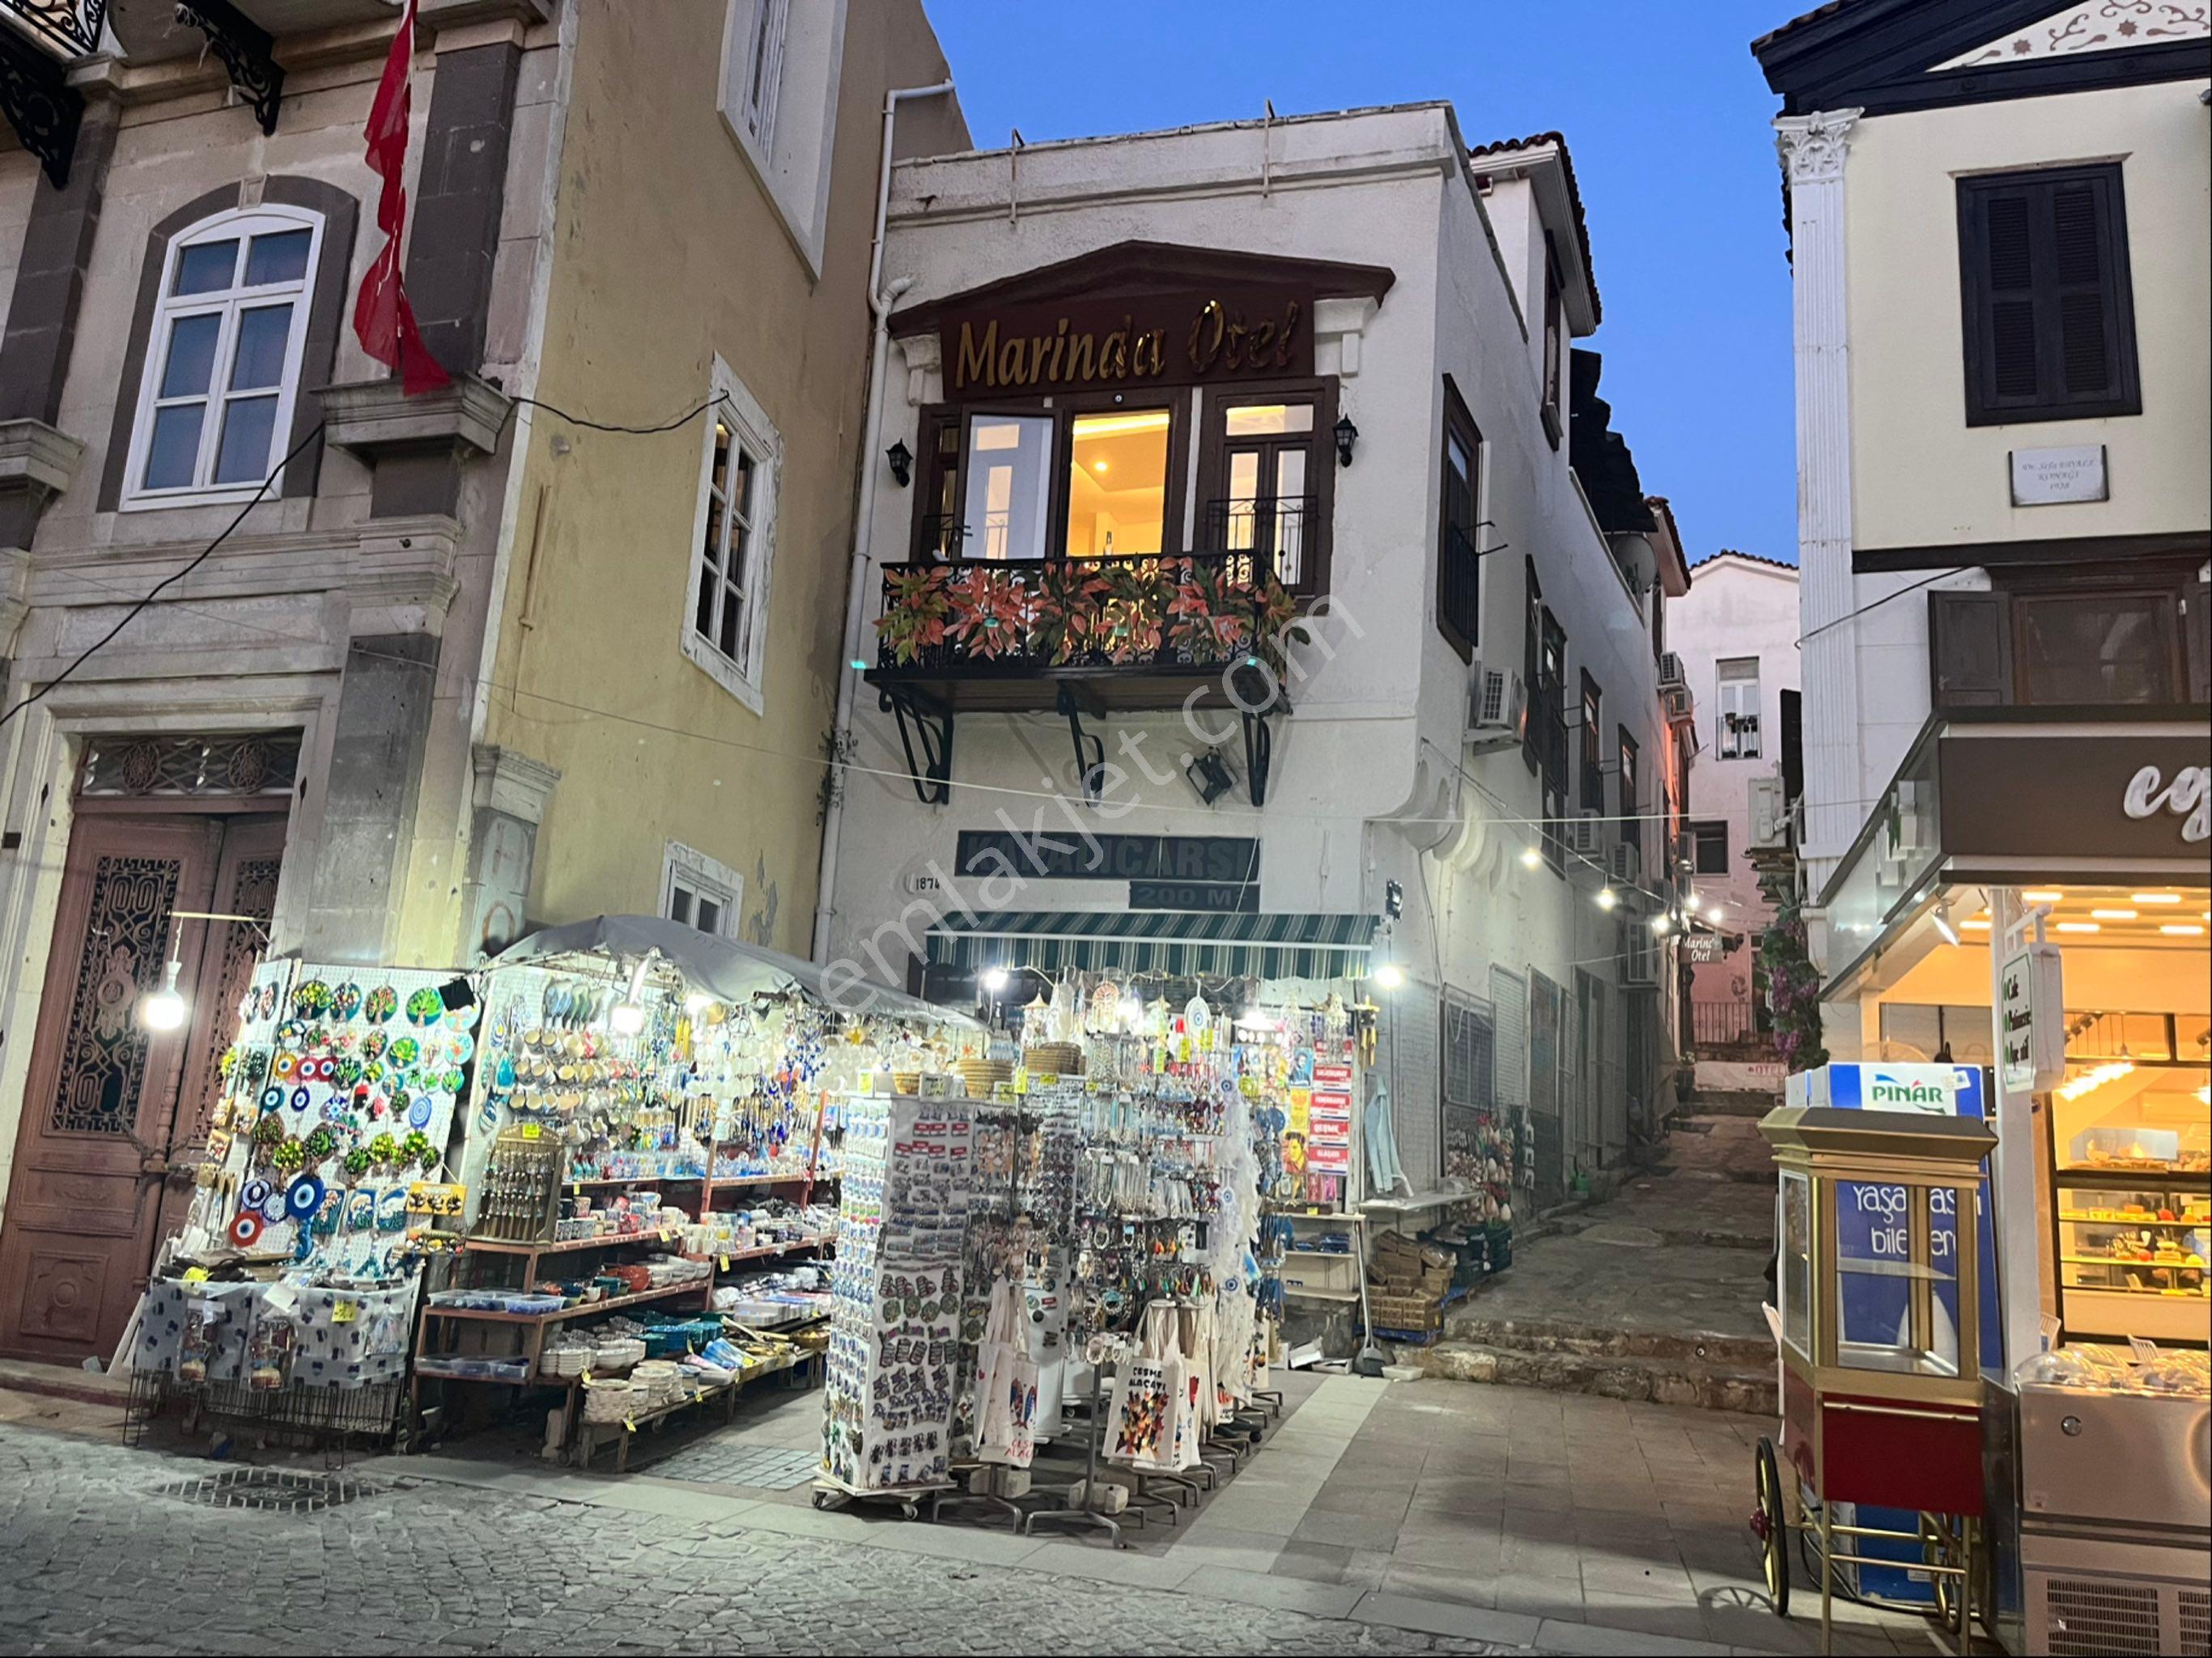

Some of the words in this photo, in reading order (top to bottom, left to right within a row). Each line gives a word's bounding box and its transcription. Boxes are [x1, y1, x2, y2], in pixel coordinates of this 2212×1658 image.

[956, 315, 1166, 388] Marinda
[1187, 299, 1301, 375] Otel
[1872, 1085, 1944, 1102] PINAR
